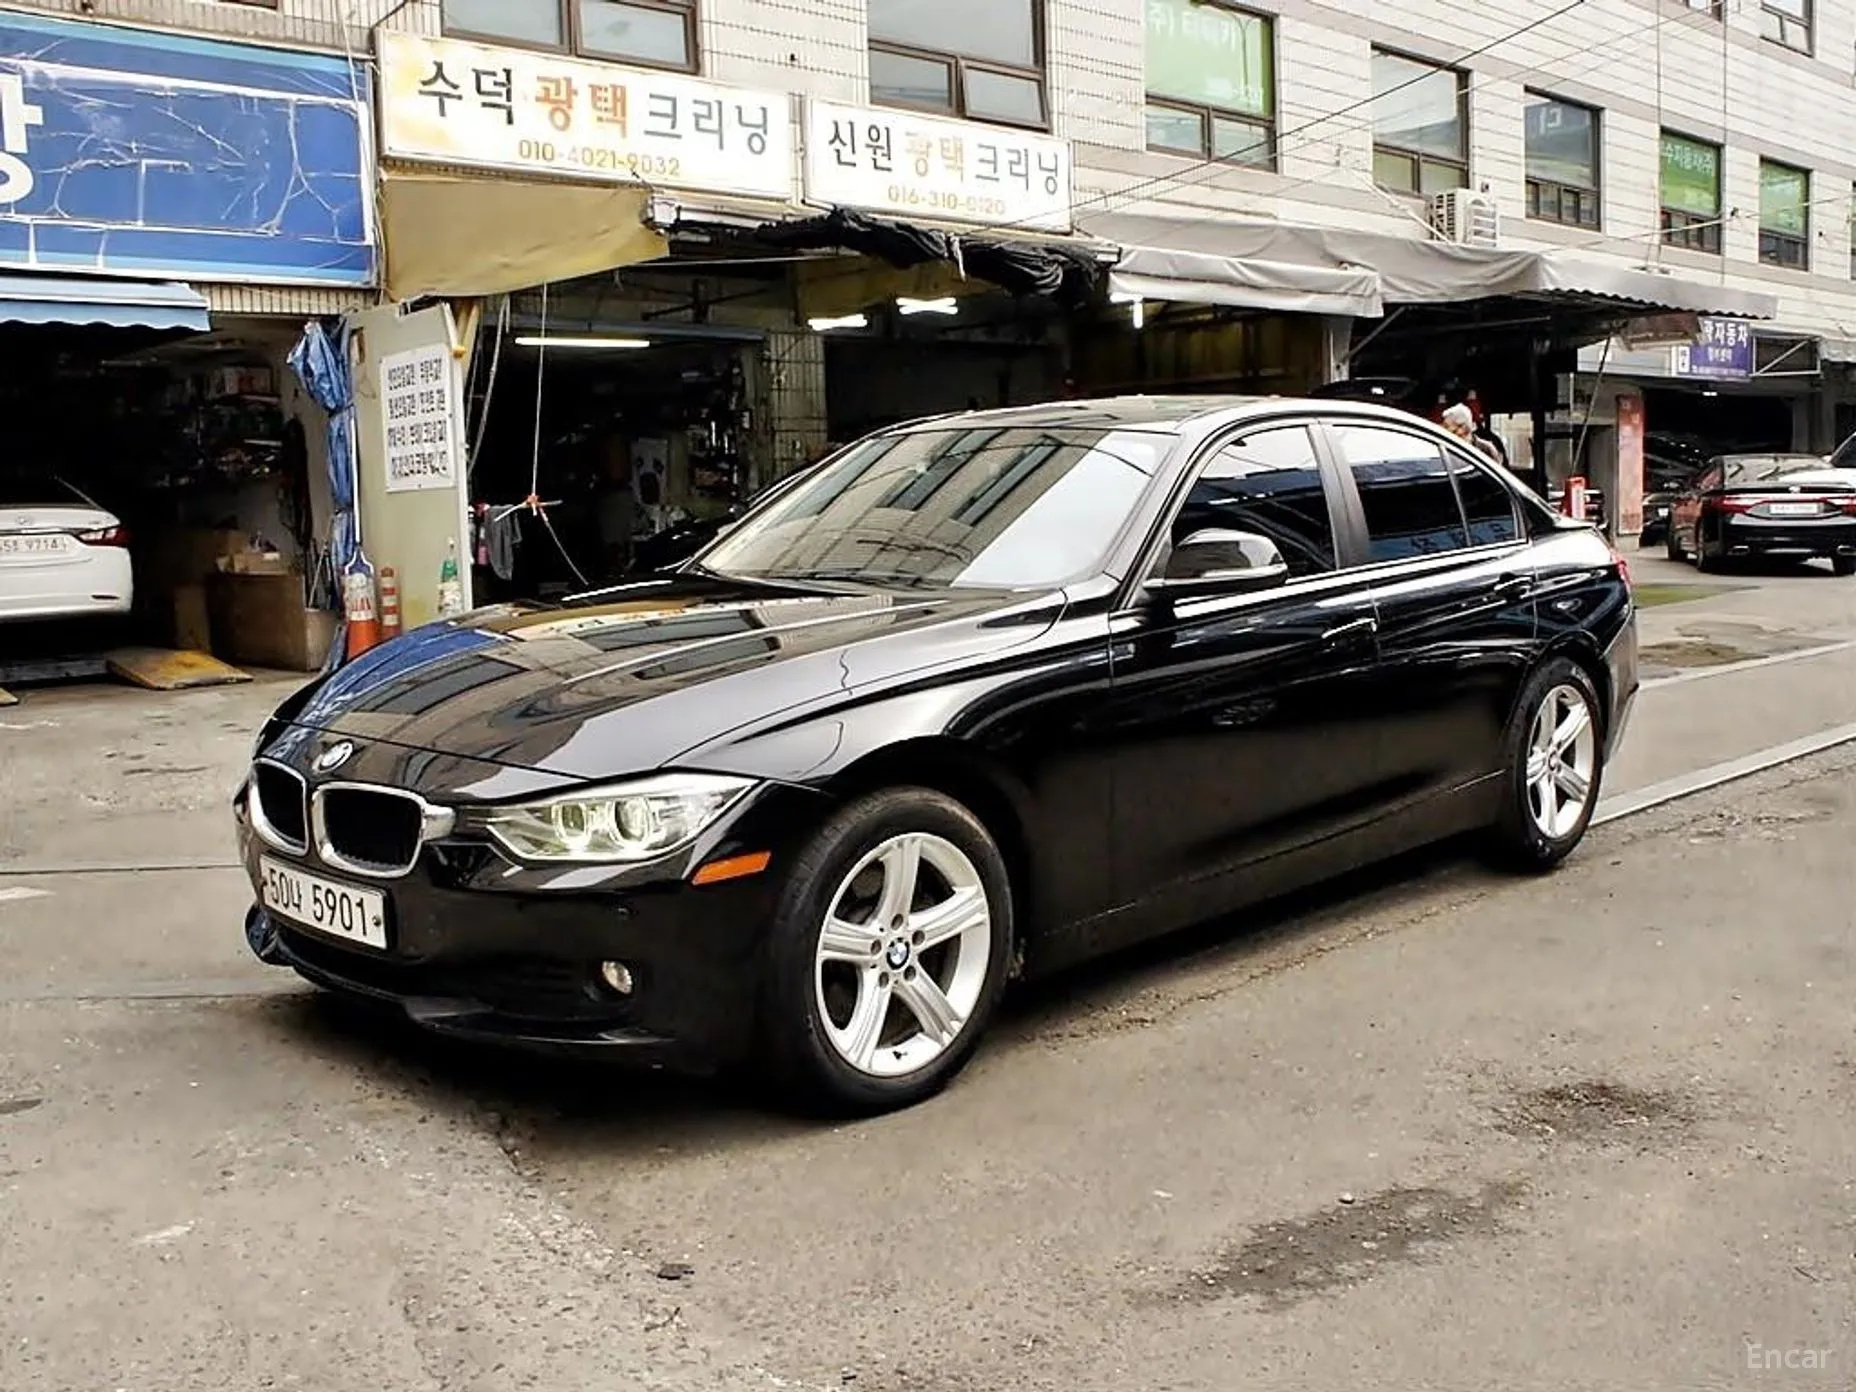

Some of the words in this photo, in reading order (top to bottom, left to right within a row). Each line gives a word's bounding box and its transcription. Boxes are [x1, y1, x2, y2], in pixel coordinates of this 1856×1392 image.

[417, 60, 514, 125] 수덕
[535, 75, 628, 138] 광택
[643, 92, 769, 155] 크리닝
[518, 139, 681, 176] 010-4021-9032
[828, 120, 893, 172] 신원
[975, 142, 1059, 196] 크리닝
[311, 883, 368, 937] 5901
